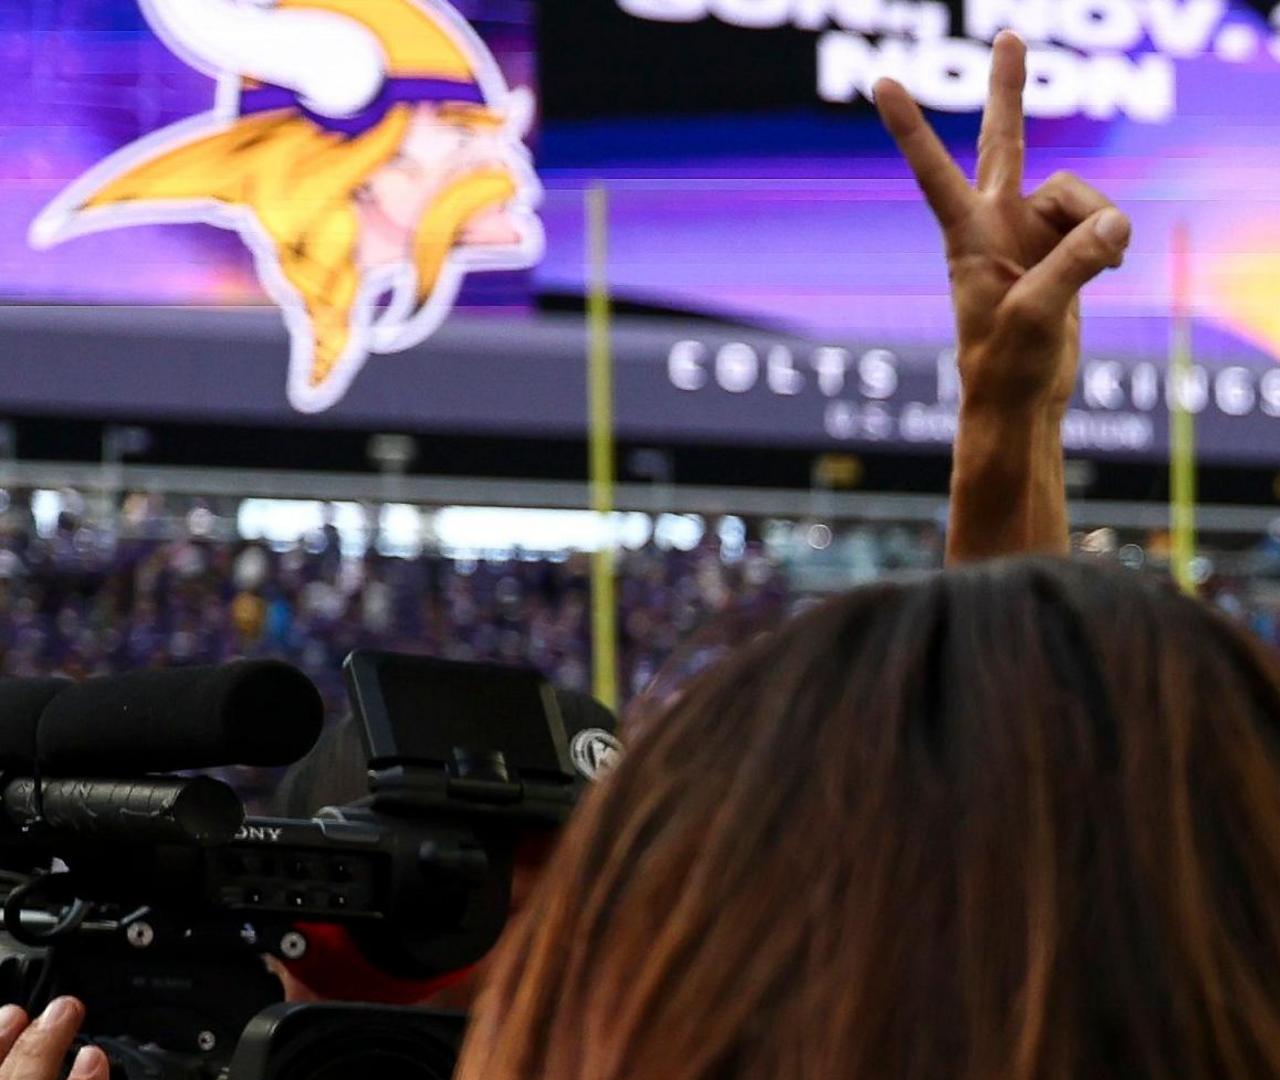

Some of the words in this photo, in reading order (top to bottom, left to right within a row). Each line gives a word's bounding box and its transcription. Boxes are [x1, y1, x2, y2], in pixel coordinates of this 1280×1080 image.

[815, 30, 1176, 123] NOON
[667, 340, 898, 398] COLTS
[234, 826, 282, 841] ONY
